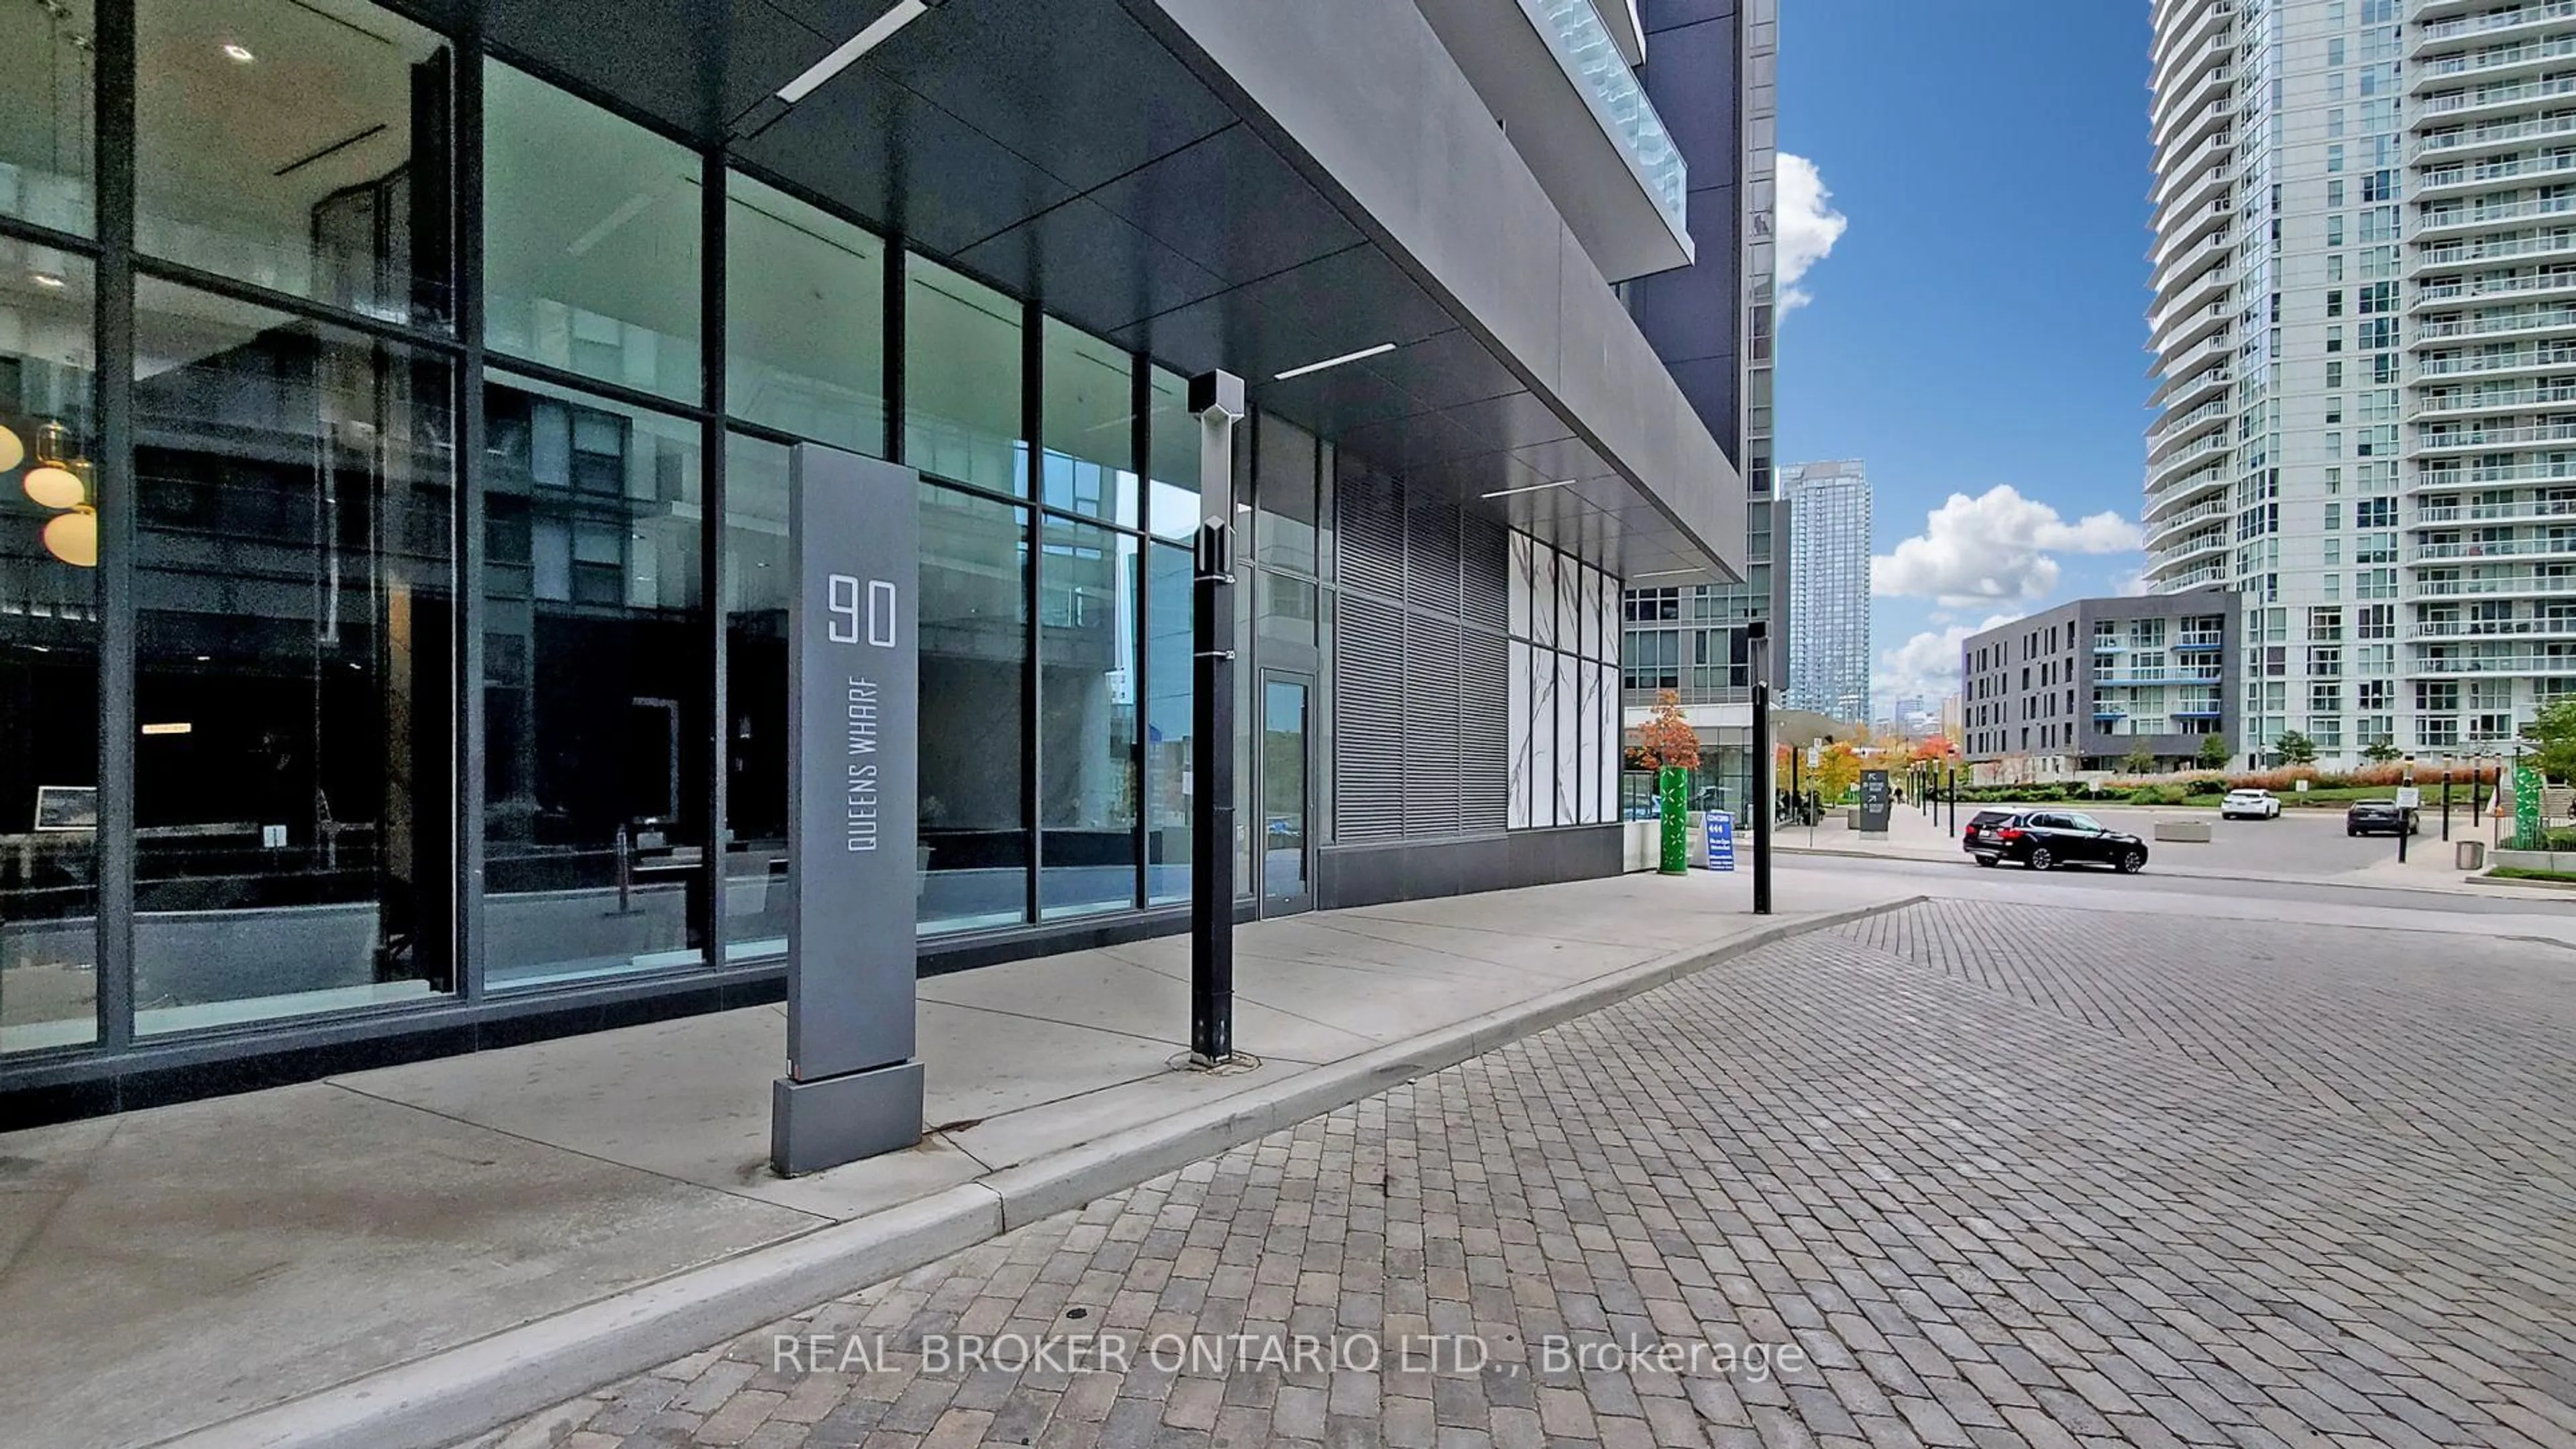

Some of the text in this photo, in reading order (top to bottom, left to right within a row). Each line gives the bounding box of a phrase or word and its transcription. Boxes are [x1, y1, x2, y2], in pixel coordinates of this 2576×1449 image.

[828, 574, 896, 648] 90
[847, 676, 877, 851] QUEENS WHARF
